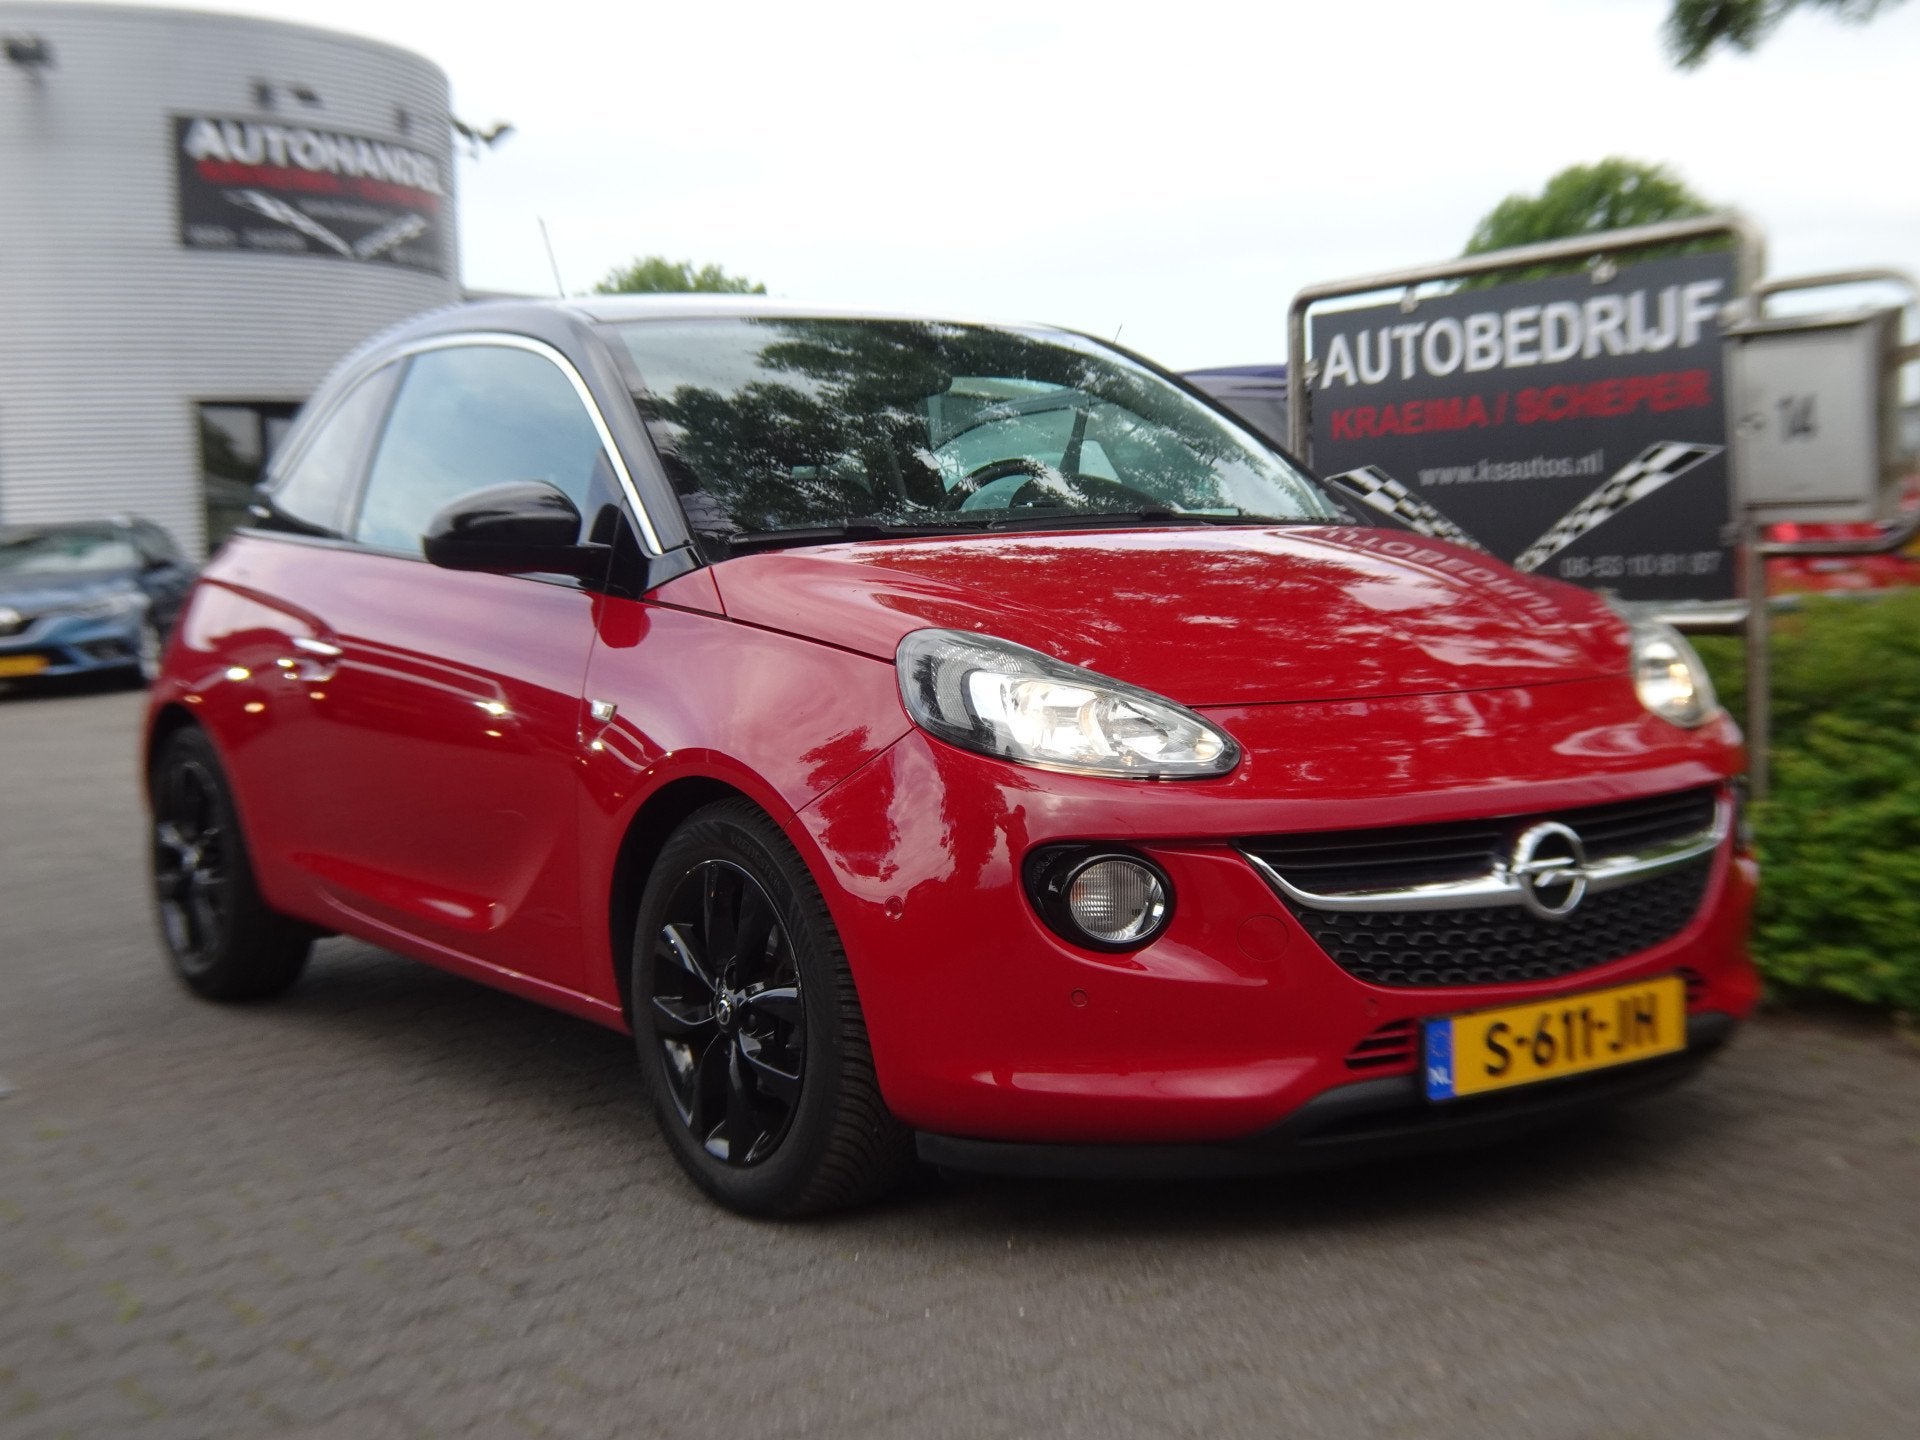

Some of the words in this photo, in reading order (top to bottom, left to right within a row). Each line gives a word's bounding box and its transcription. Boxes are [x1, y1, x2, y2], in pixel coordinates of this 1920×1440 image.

[1320, 278, 1725, 389] AUTOBEDRIJF
[1330, 394, 1489, 441] KRAEIMA
[1516, 368, 1712, 426] SCHEPER
[1485, 992, 1658, 1077] S-611-JH
